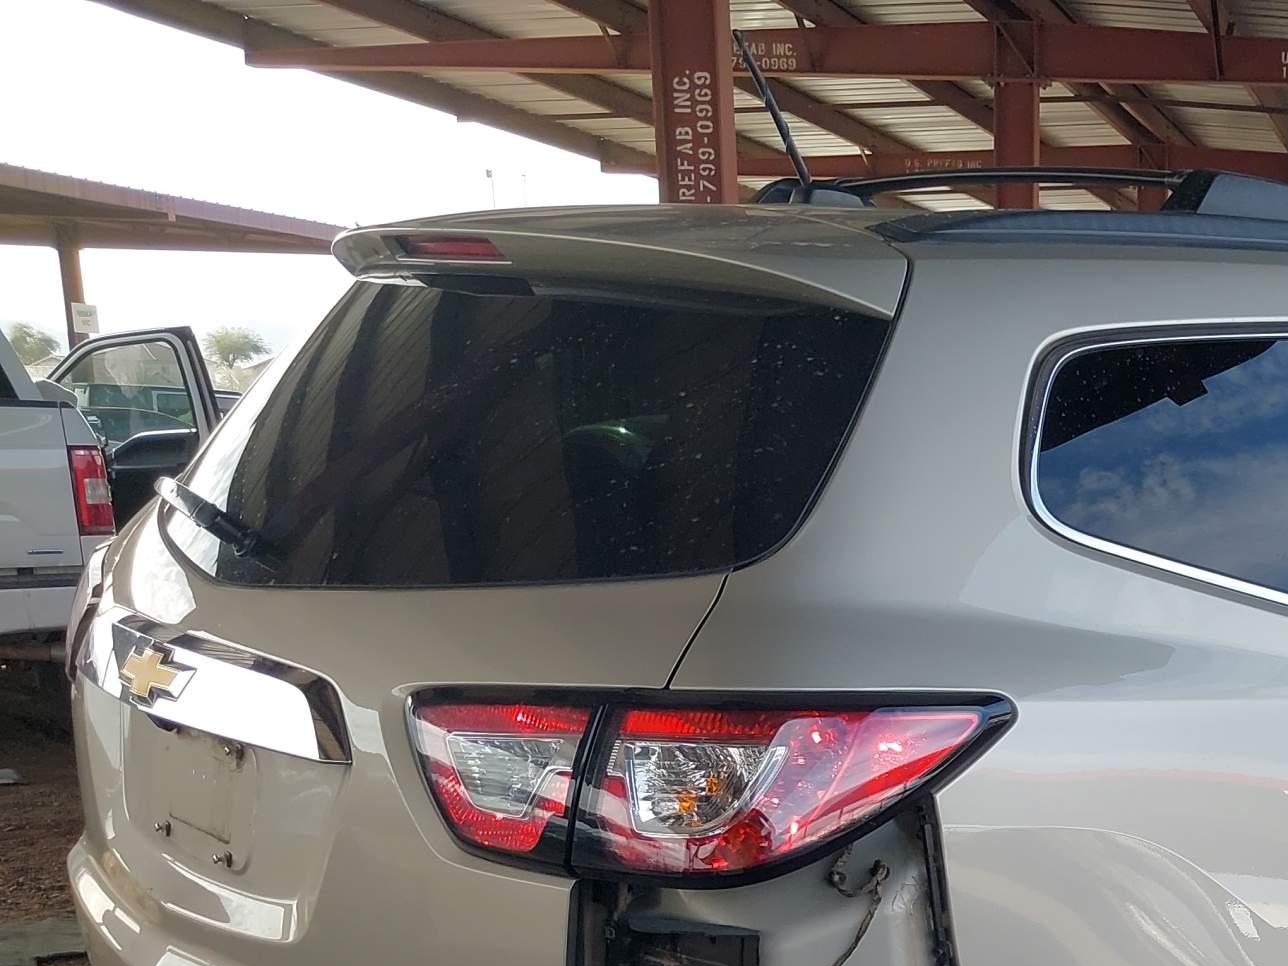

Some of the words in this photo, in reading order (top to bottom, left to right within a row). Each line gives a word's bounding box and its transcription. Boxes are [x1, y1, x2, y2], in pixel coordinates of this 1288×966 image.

[772, 43, 797, 56] INC.
[673, 69, 691, 112] INC.
[676, 127, 695, 200] REFAB
[695, 72, 717, 203] -799-0969
